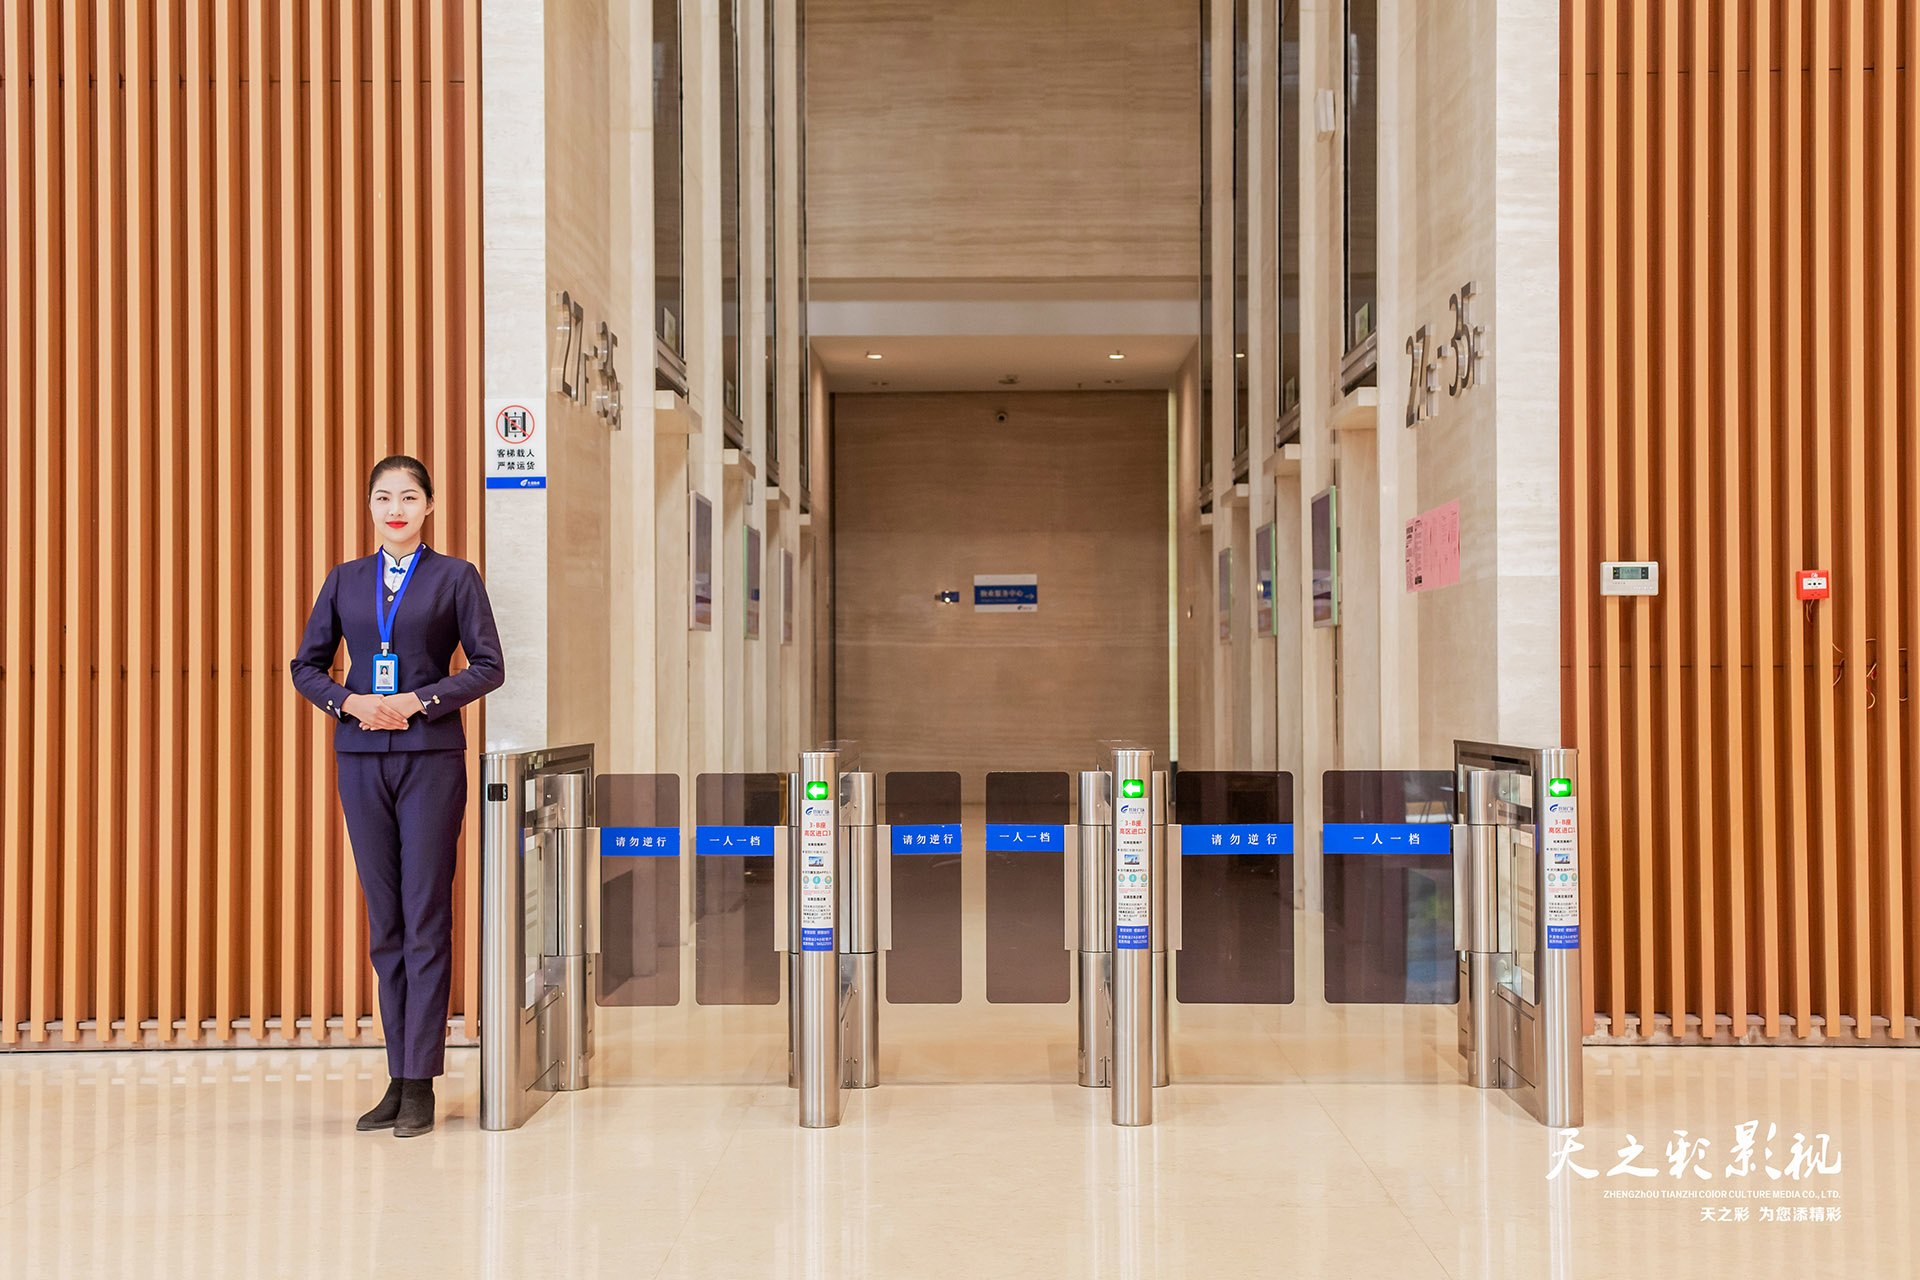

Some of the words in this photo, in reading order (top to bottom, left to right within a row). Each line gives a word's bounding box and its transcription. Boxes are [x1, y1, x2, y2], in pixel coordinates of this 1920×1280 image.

[496, 448, 535, 458] 客梯载人
[496, 461, 535, 470] 严禁运货
[615, 836, 667, 848] 请勿逆行
[709, 835, 761, 847] 一人一档
[903, 833, 954, 845] 请勿逆行
[999, 831, 1051, 843] 一人一档
[1211, 833, 1278, 845] 请勿逆行
[1353, 832, 1421, 845] 一人一档
